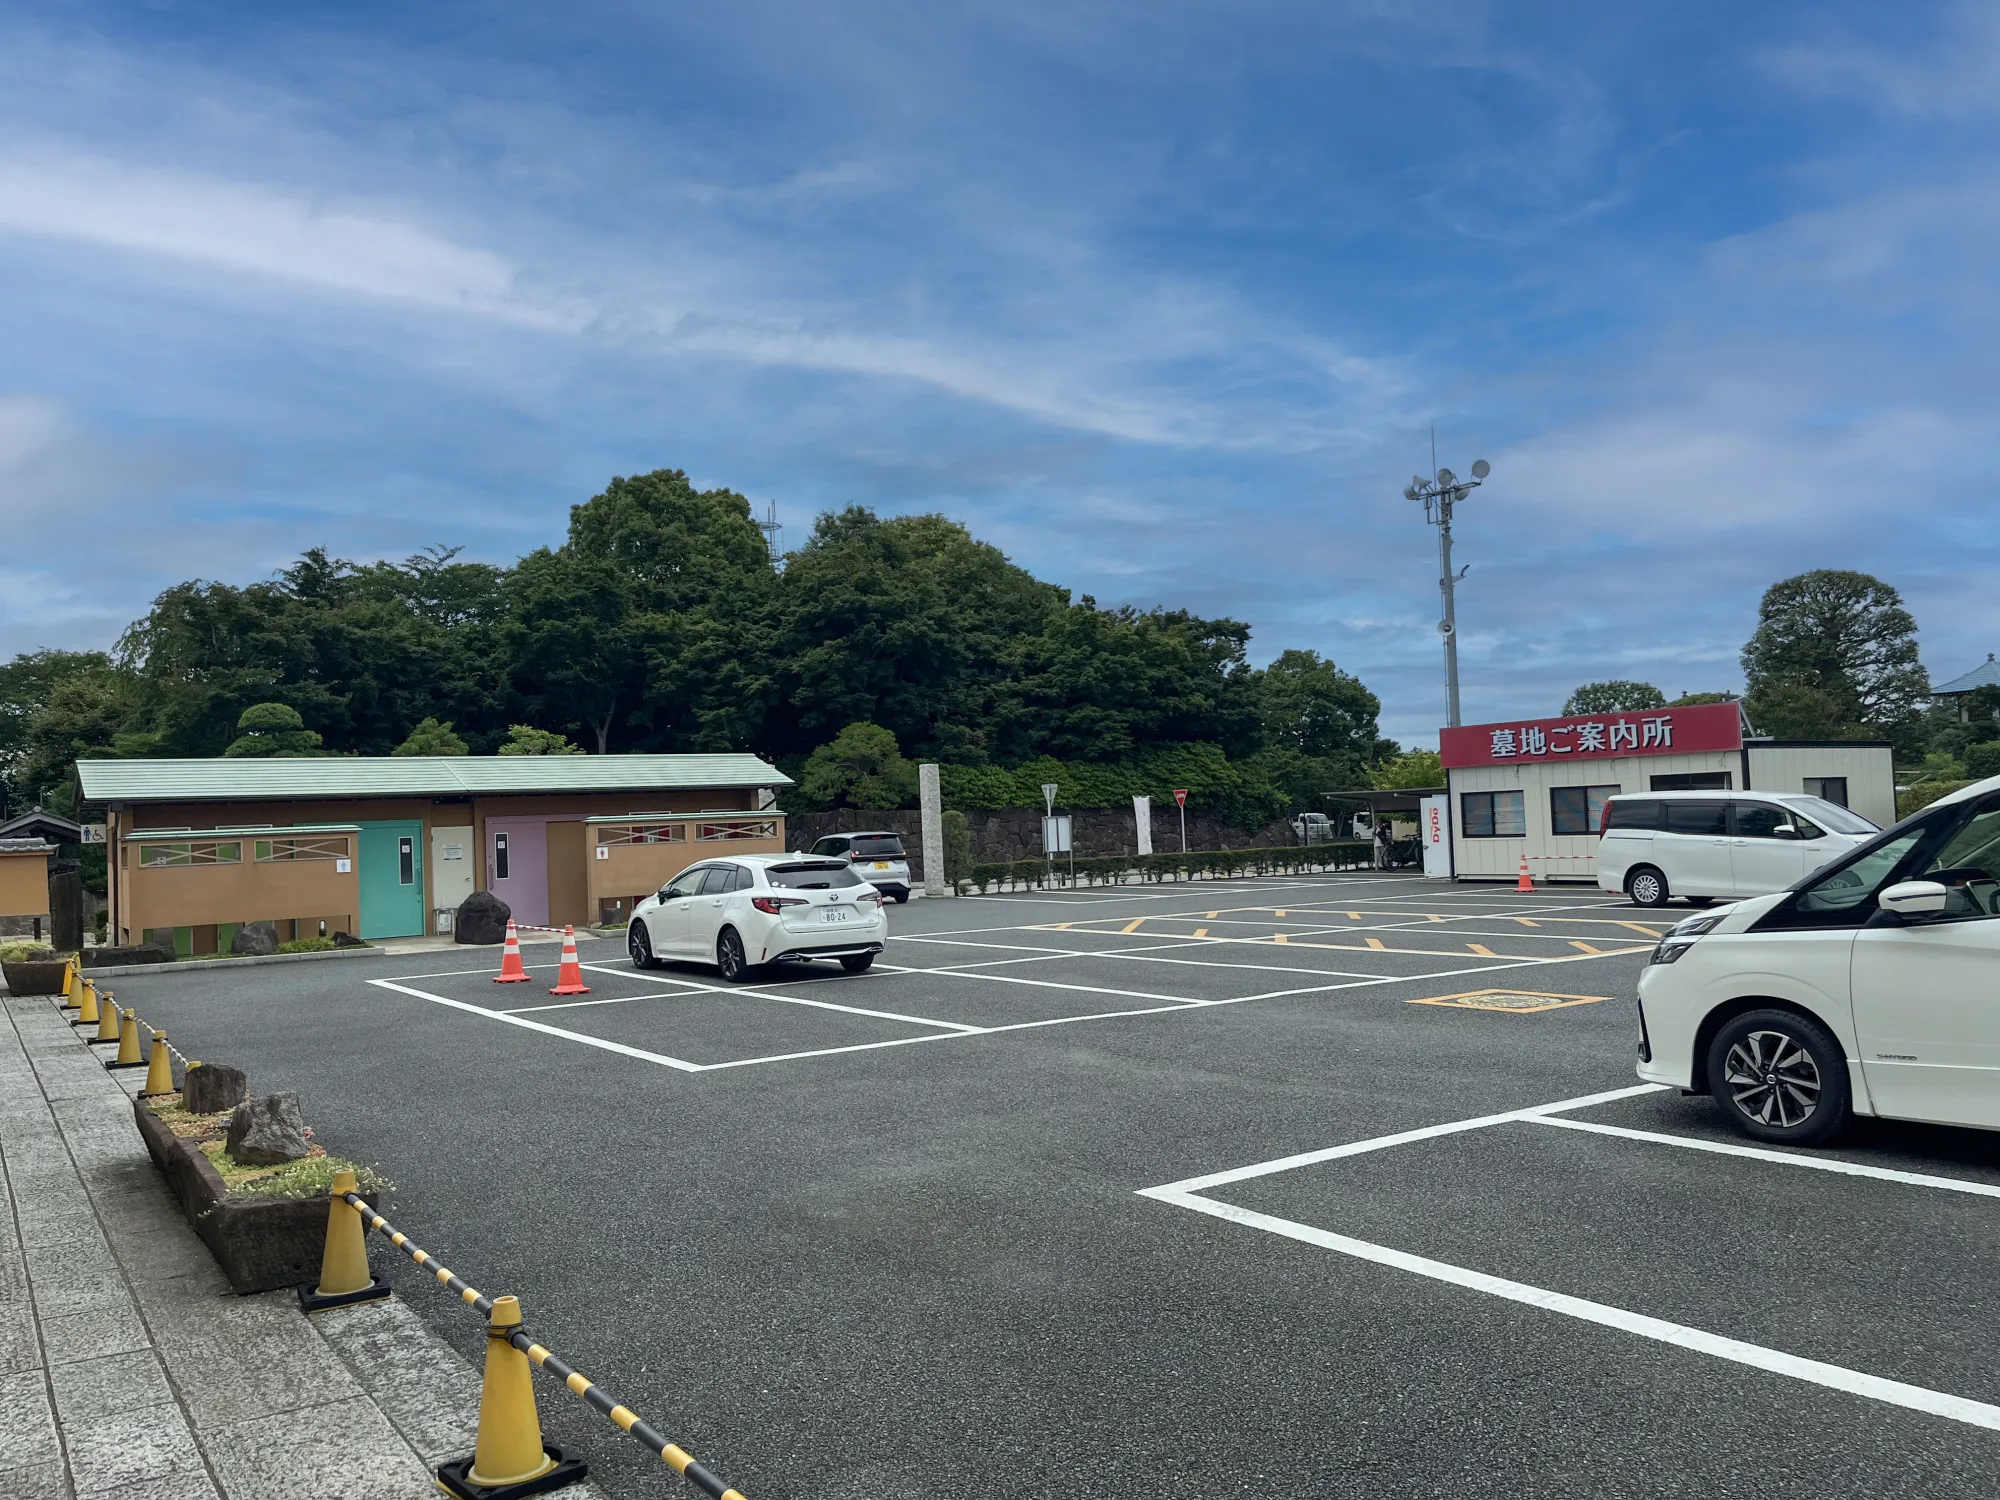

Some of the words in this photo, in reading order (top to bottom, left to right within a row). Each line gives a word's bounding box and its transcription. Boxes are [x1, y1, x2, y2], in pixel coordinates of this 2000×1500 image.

[1490, 715, 1673, 757] 墓地ご案内所
[1432, 807, 1441, 843] DyDo
[826, 912, 846, 922] 80-24
